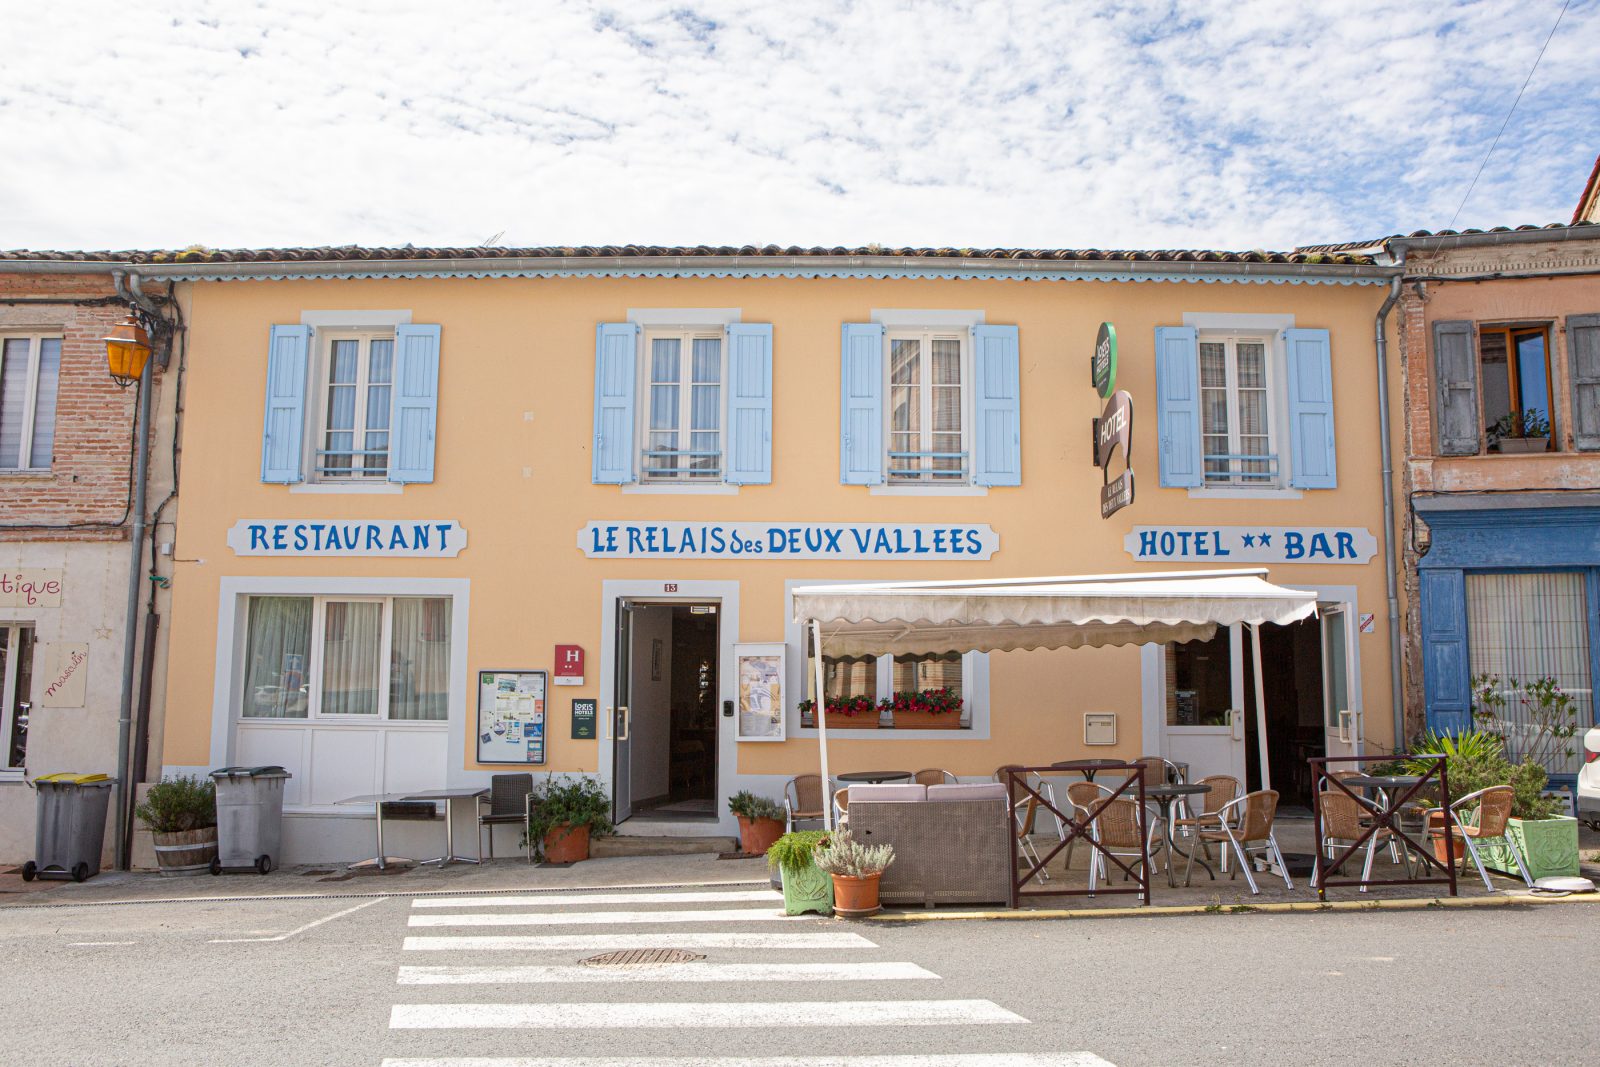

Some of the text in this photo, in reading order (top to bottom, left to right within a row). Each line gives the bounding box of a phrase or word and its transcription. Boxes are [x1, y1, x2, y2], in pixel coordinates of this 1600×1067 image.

[1100, 405, 1127, 446] HOTEL
[248, 524, 452, 551] RESTAURANT
[591, 526, 983, 555] LE RELAIS des DEUX VALLEES
[1139, 530, 1358, 560] HOTEL BAR
[665, 584, 677, 592] 13
[566, 649, 580, 662] H
